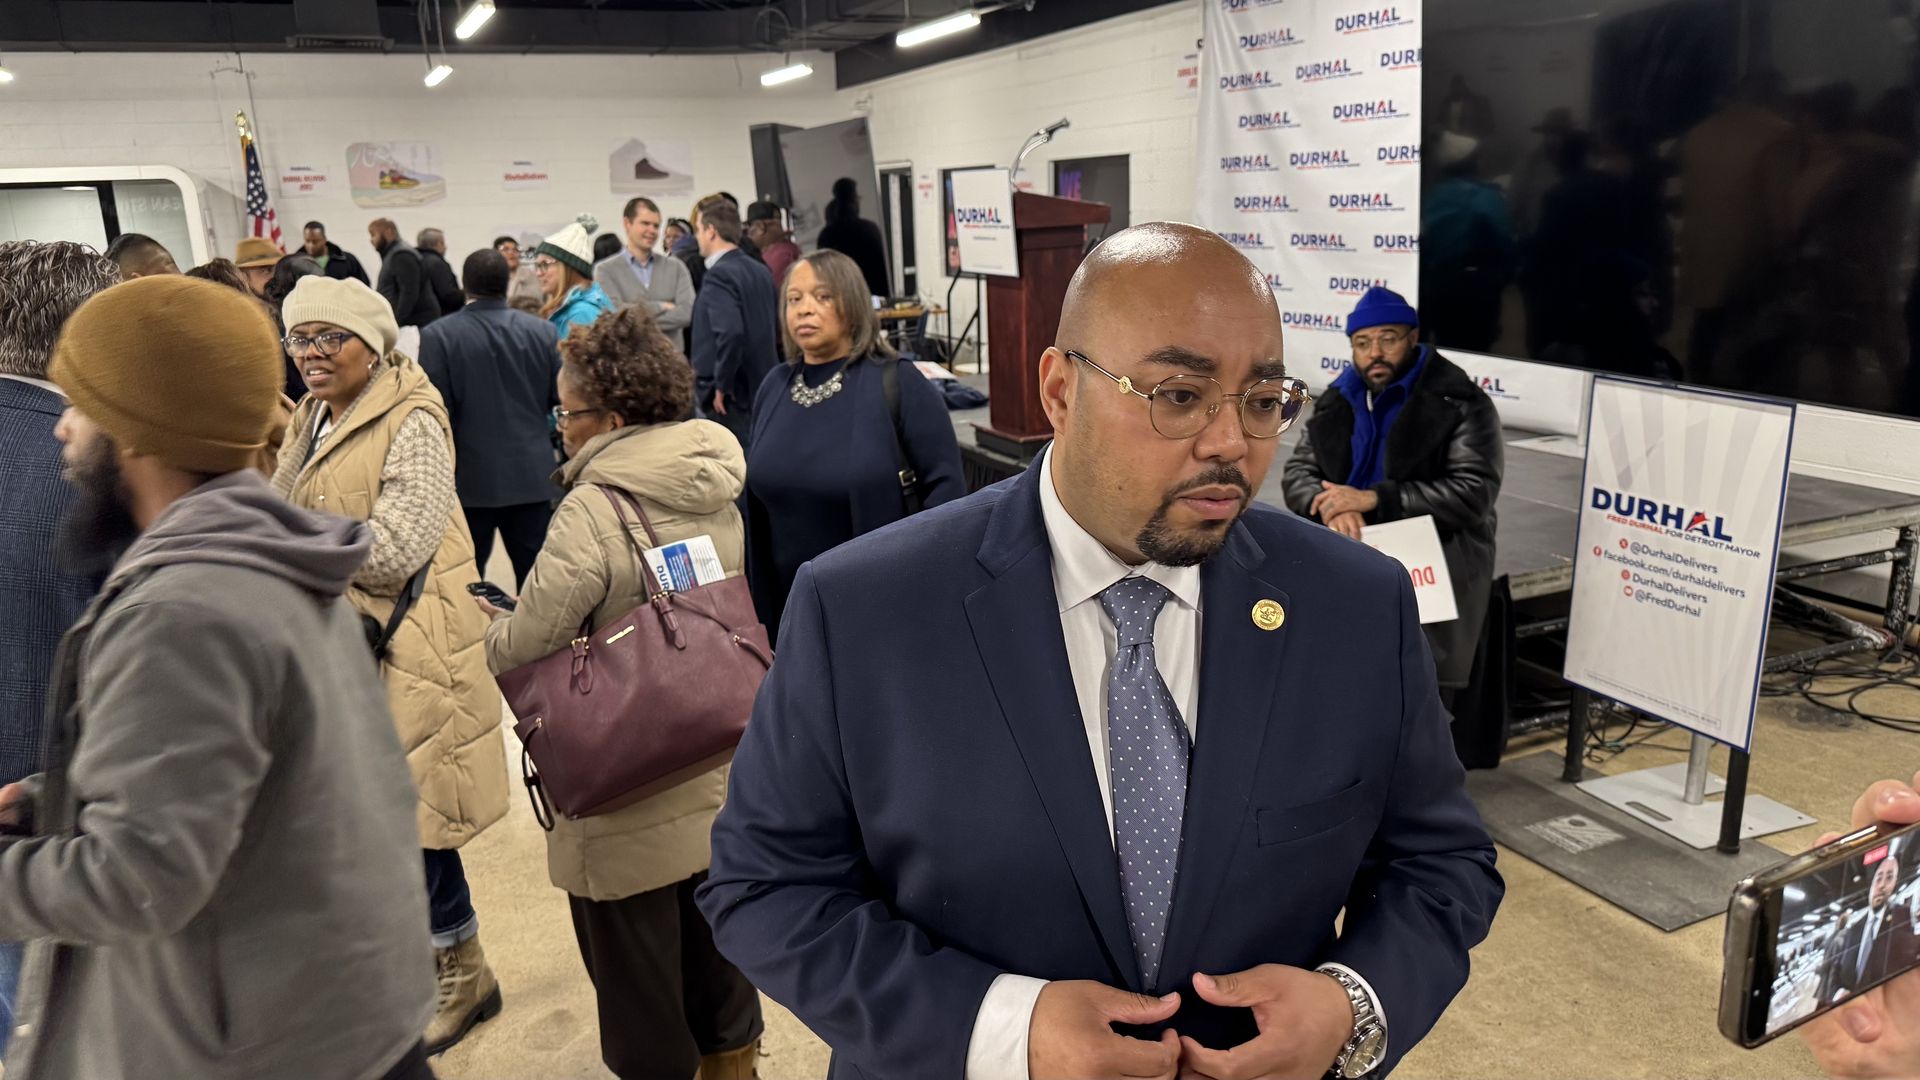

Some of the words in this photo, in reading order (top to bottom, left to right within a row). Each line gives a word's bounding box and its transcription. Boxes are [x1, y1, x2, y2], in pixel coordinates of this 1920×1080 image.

[1335, 8, 1400, 31] DURHAL
[1239, 28, 1294, 48] DURHAL
[1381, 48, 1421, 67] DUR
[1296, 59, 1351, 79] DURHAL
[1220, 71, 1272, 88] DURHAL
[1333, 100, 1397, 119] DURHAL
[1239, 112, 1290, 128] DURHAL
[1290, 150, 1349, 165] DURHAL
[1377, 145, 1421, 160] DURH
[1221, 155, 1270, 169] DURHAL
[1234, 195, 1290, 209] DURHAL
[1329, 193, 1392, 207] DURHAL
[957, 208, 1001, 223] DURHAL
[1291, 233, 1345, 247] DURHAL
[1374, 234, 1420, 248] DURH
[1283, 312, 1342, 328] DURHAL
[1591, 487, 1733, 542] DURHAL
[1606, 513, 1627, 526] FRED
[1629, 518, 1664, 535] DURHAL
[1665, 528, 1684, 540] FOR
[1684, 531, 1724, 550] DETROIT
[1725, 543, 1761, 559] MAYOR
[1630, 541, 1718, 575] @DurhalDelivers
[1604, 549, 1746, 598] facebook.com/durhaldelivers
[1632, 572, 1708, 604] DurhalDelivers
[1635, 590, 1701, 617] @FredDurhal
